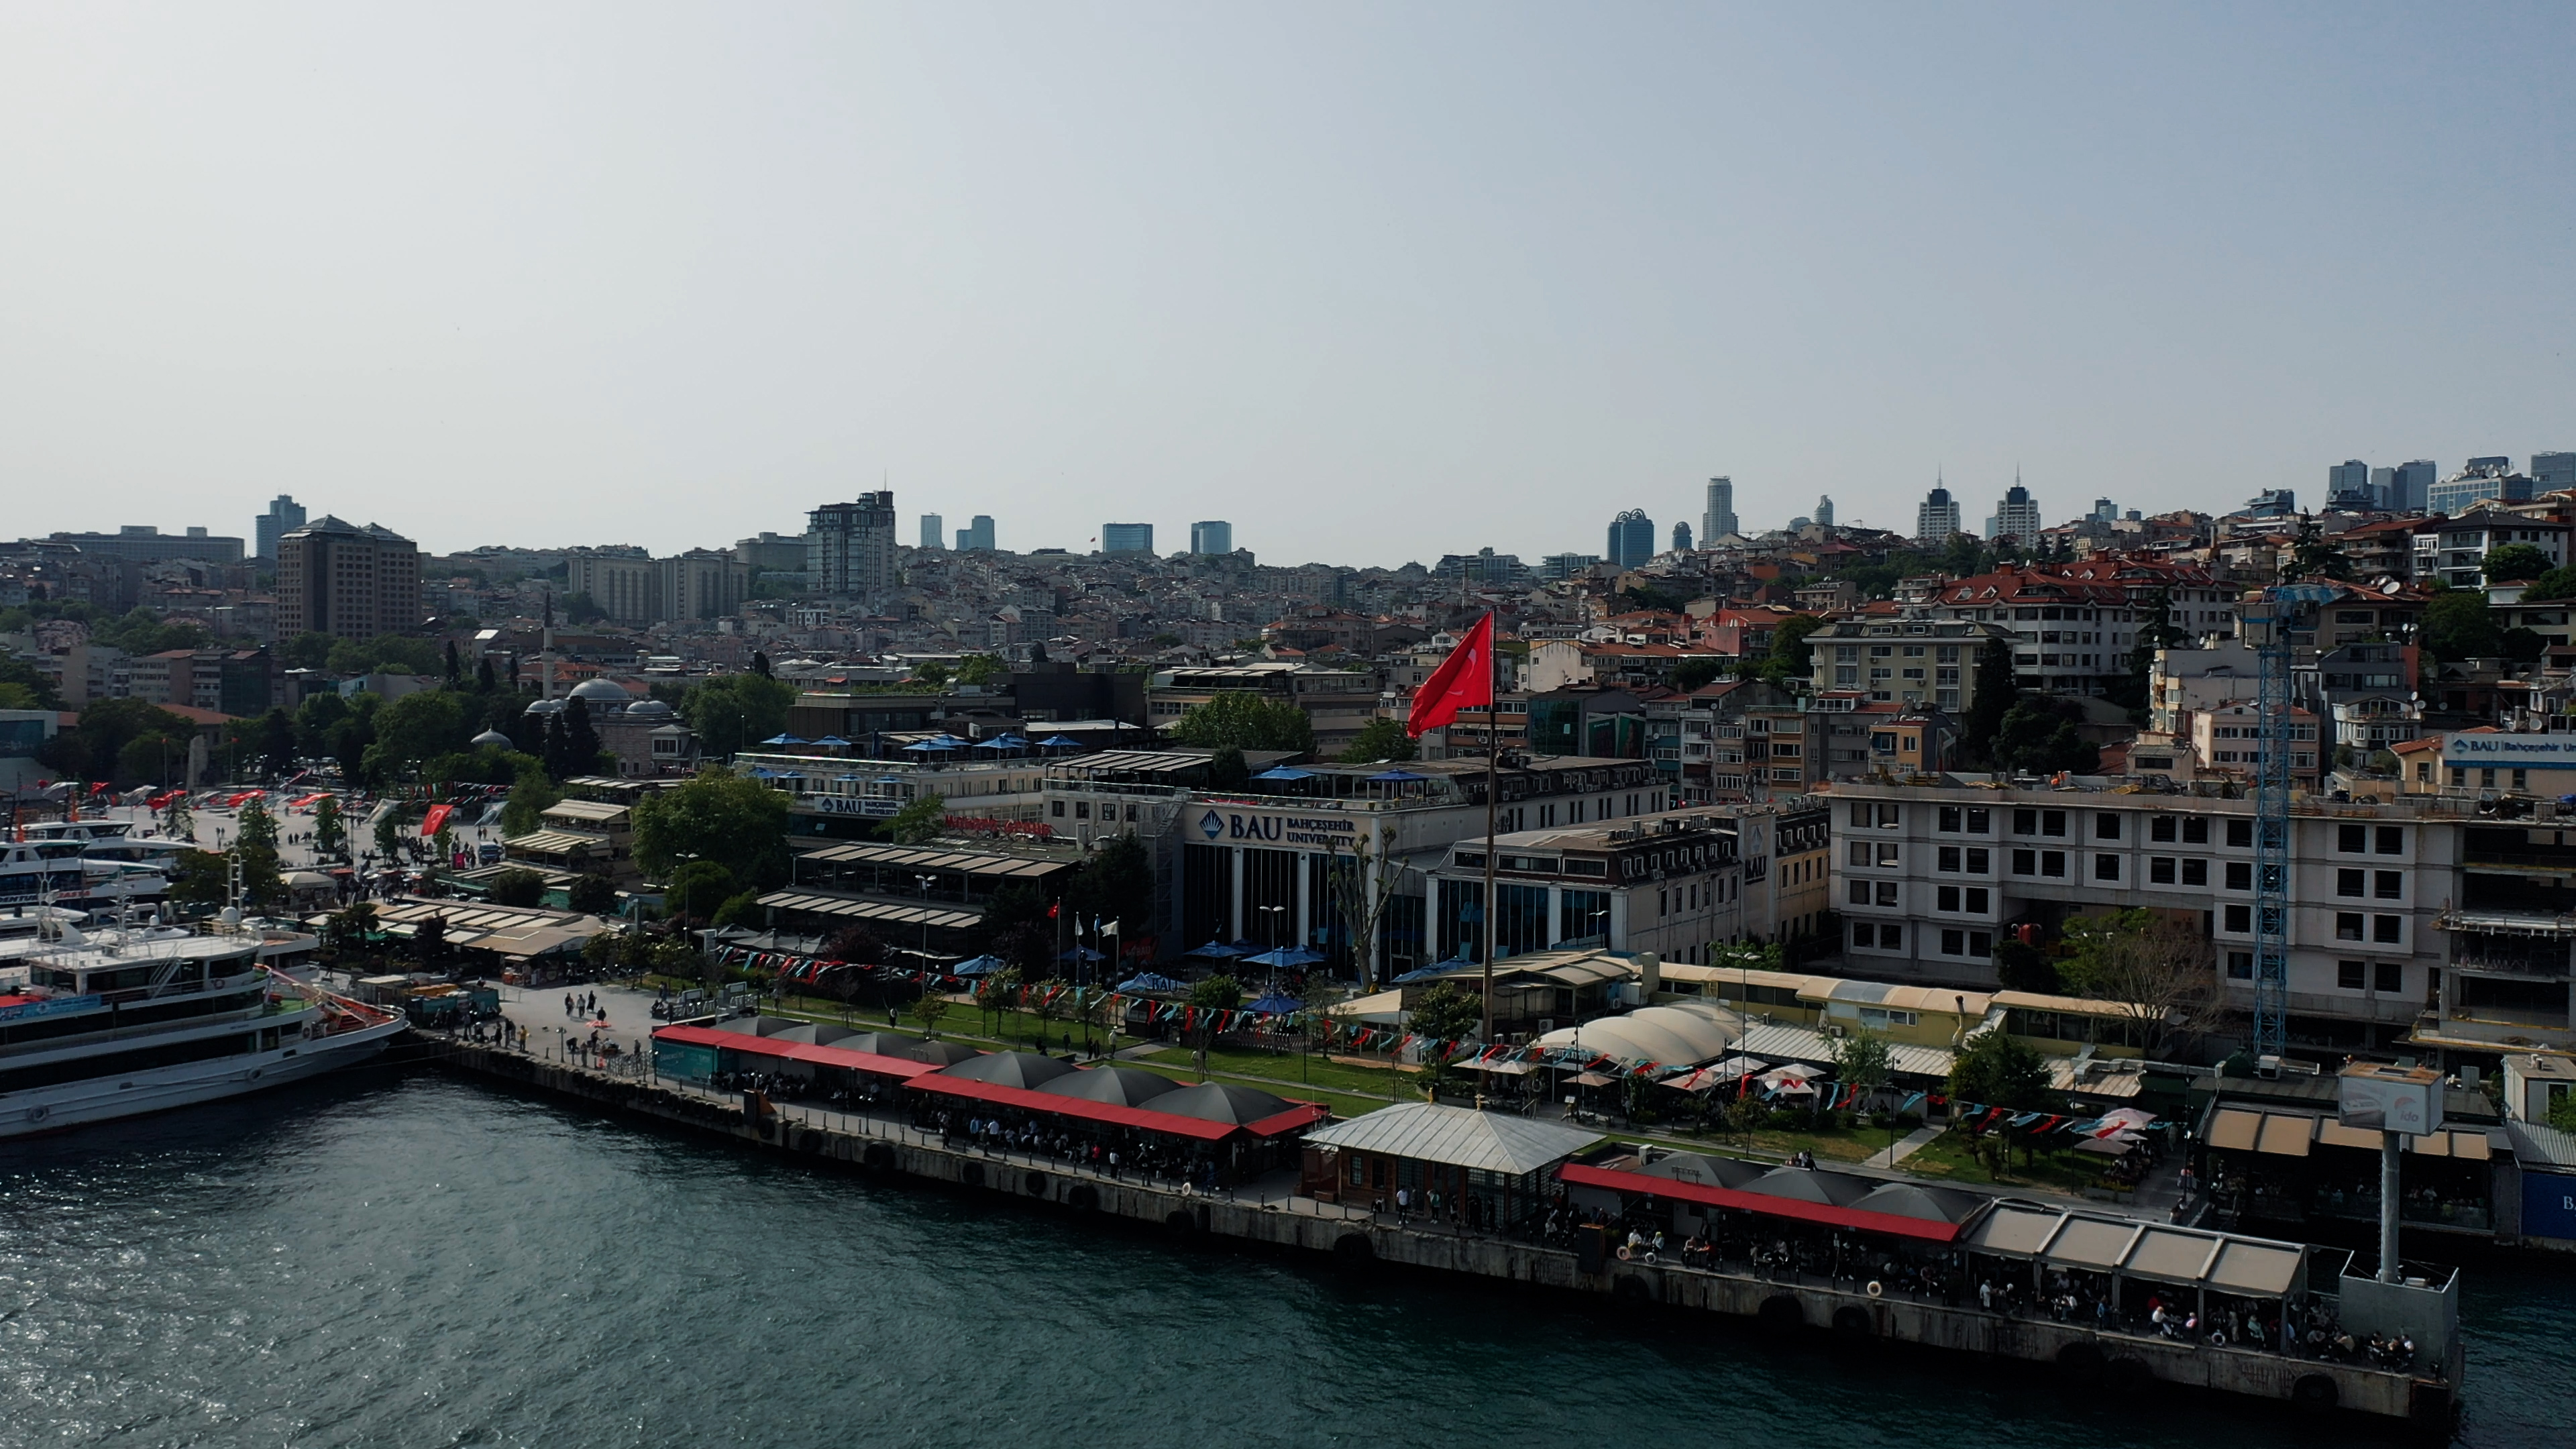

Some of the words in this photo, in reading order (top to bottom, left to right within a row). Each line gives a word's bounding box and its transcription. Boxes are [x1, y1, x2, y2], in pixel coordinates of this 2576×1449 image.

[2470, 741, 2499, 751] BAU
[835, 799, 861, 814] BAU
[1229, 814, 1282, 841] BAU
[1287, 817, 1355, 832] BAHÇEŞEHİR
[1745, 855, 1767, 879] BAU
[1152, 978, 1178, 992] BAU
